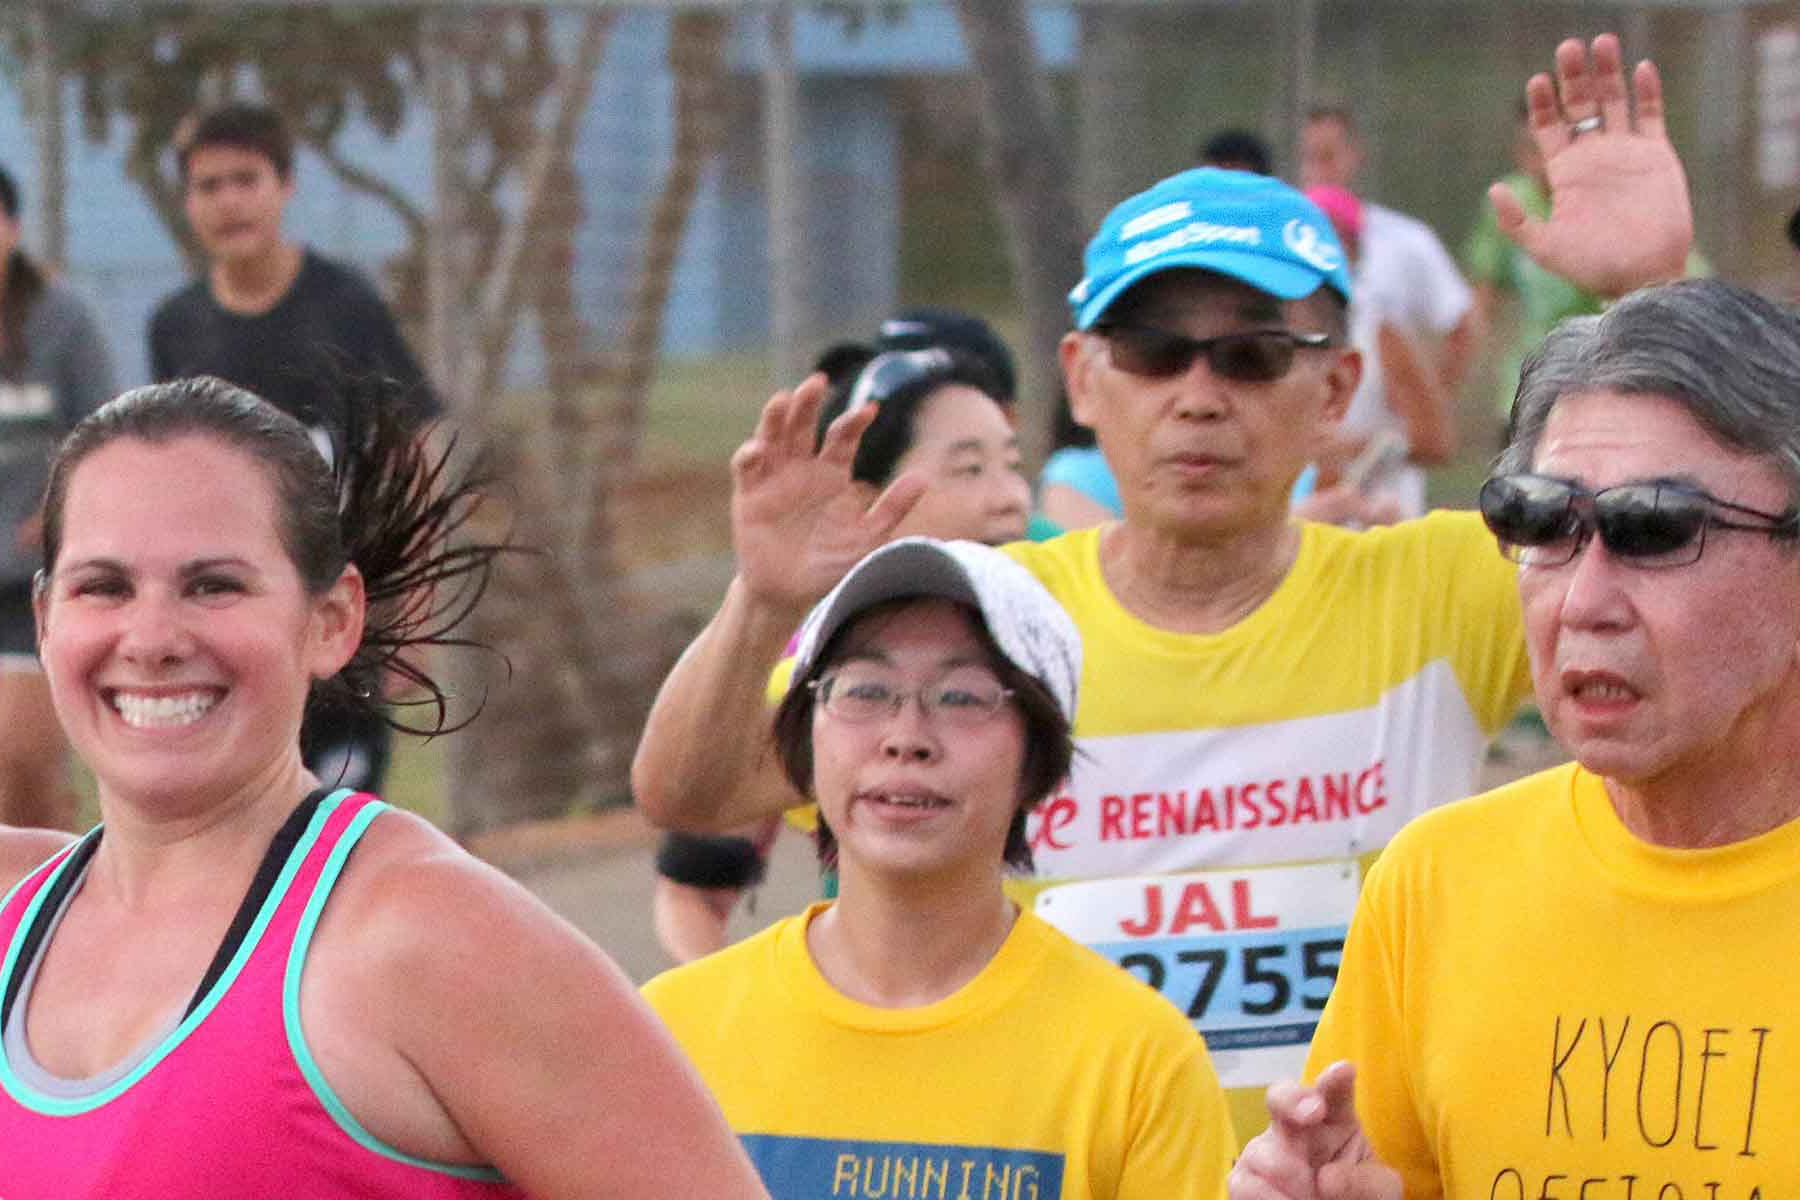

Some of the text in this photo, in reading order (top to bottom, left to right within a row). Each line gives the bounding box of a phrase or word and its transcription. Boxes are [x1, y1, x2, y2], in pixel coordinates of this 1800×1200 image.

[1100, 760, 1388, 842] RENAISSANC
[1118, 880, 1279, 938] JAL
[1544, 1014, 1771, 1157] KYOEI
